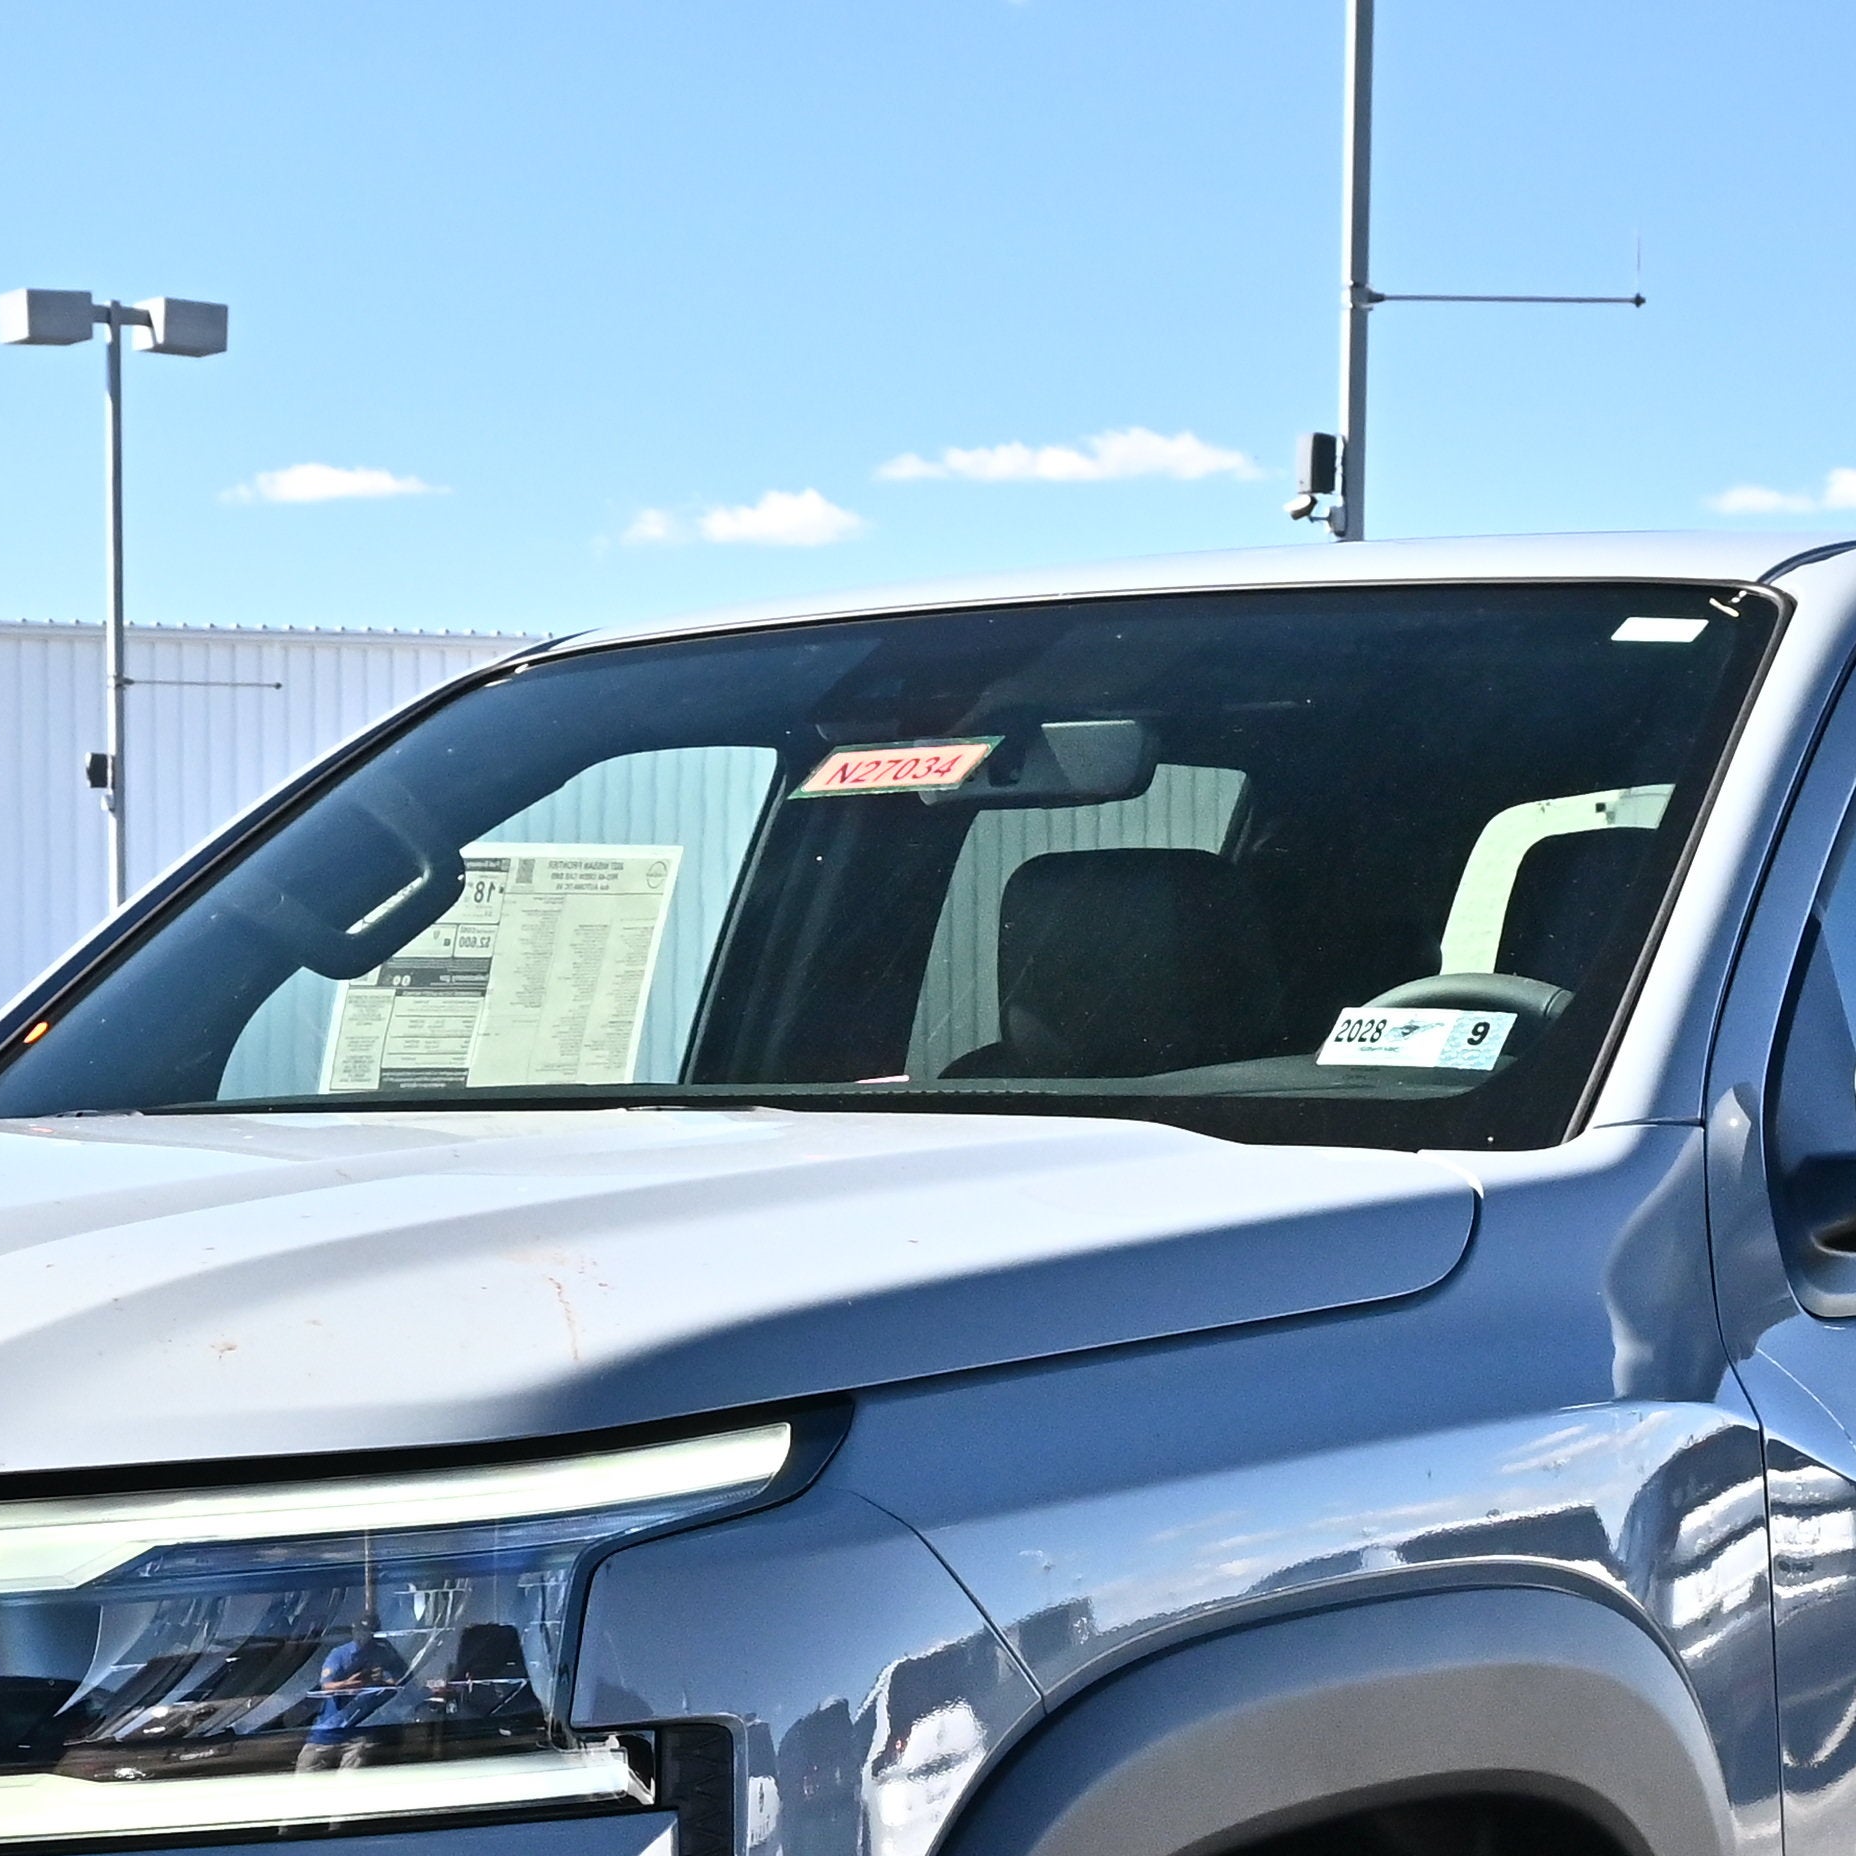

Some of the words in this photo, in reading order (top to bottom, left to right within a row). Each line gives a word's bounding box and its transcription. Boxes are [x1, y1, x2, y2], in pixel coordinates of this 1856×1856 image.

[824, 754, 963, 786] N27034
[1334, 1018, 1388, 1043] 2028
[1466, 1021, 1491, 1046] 9
